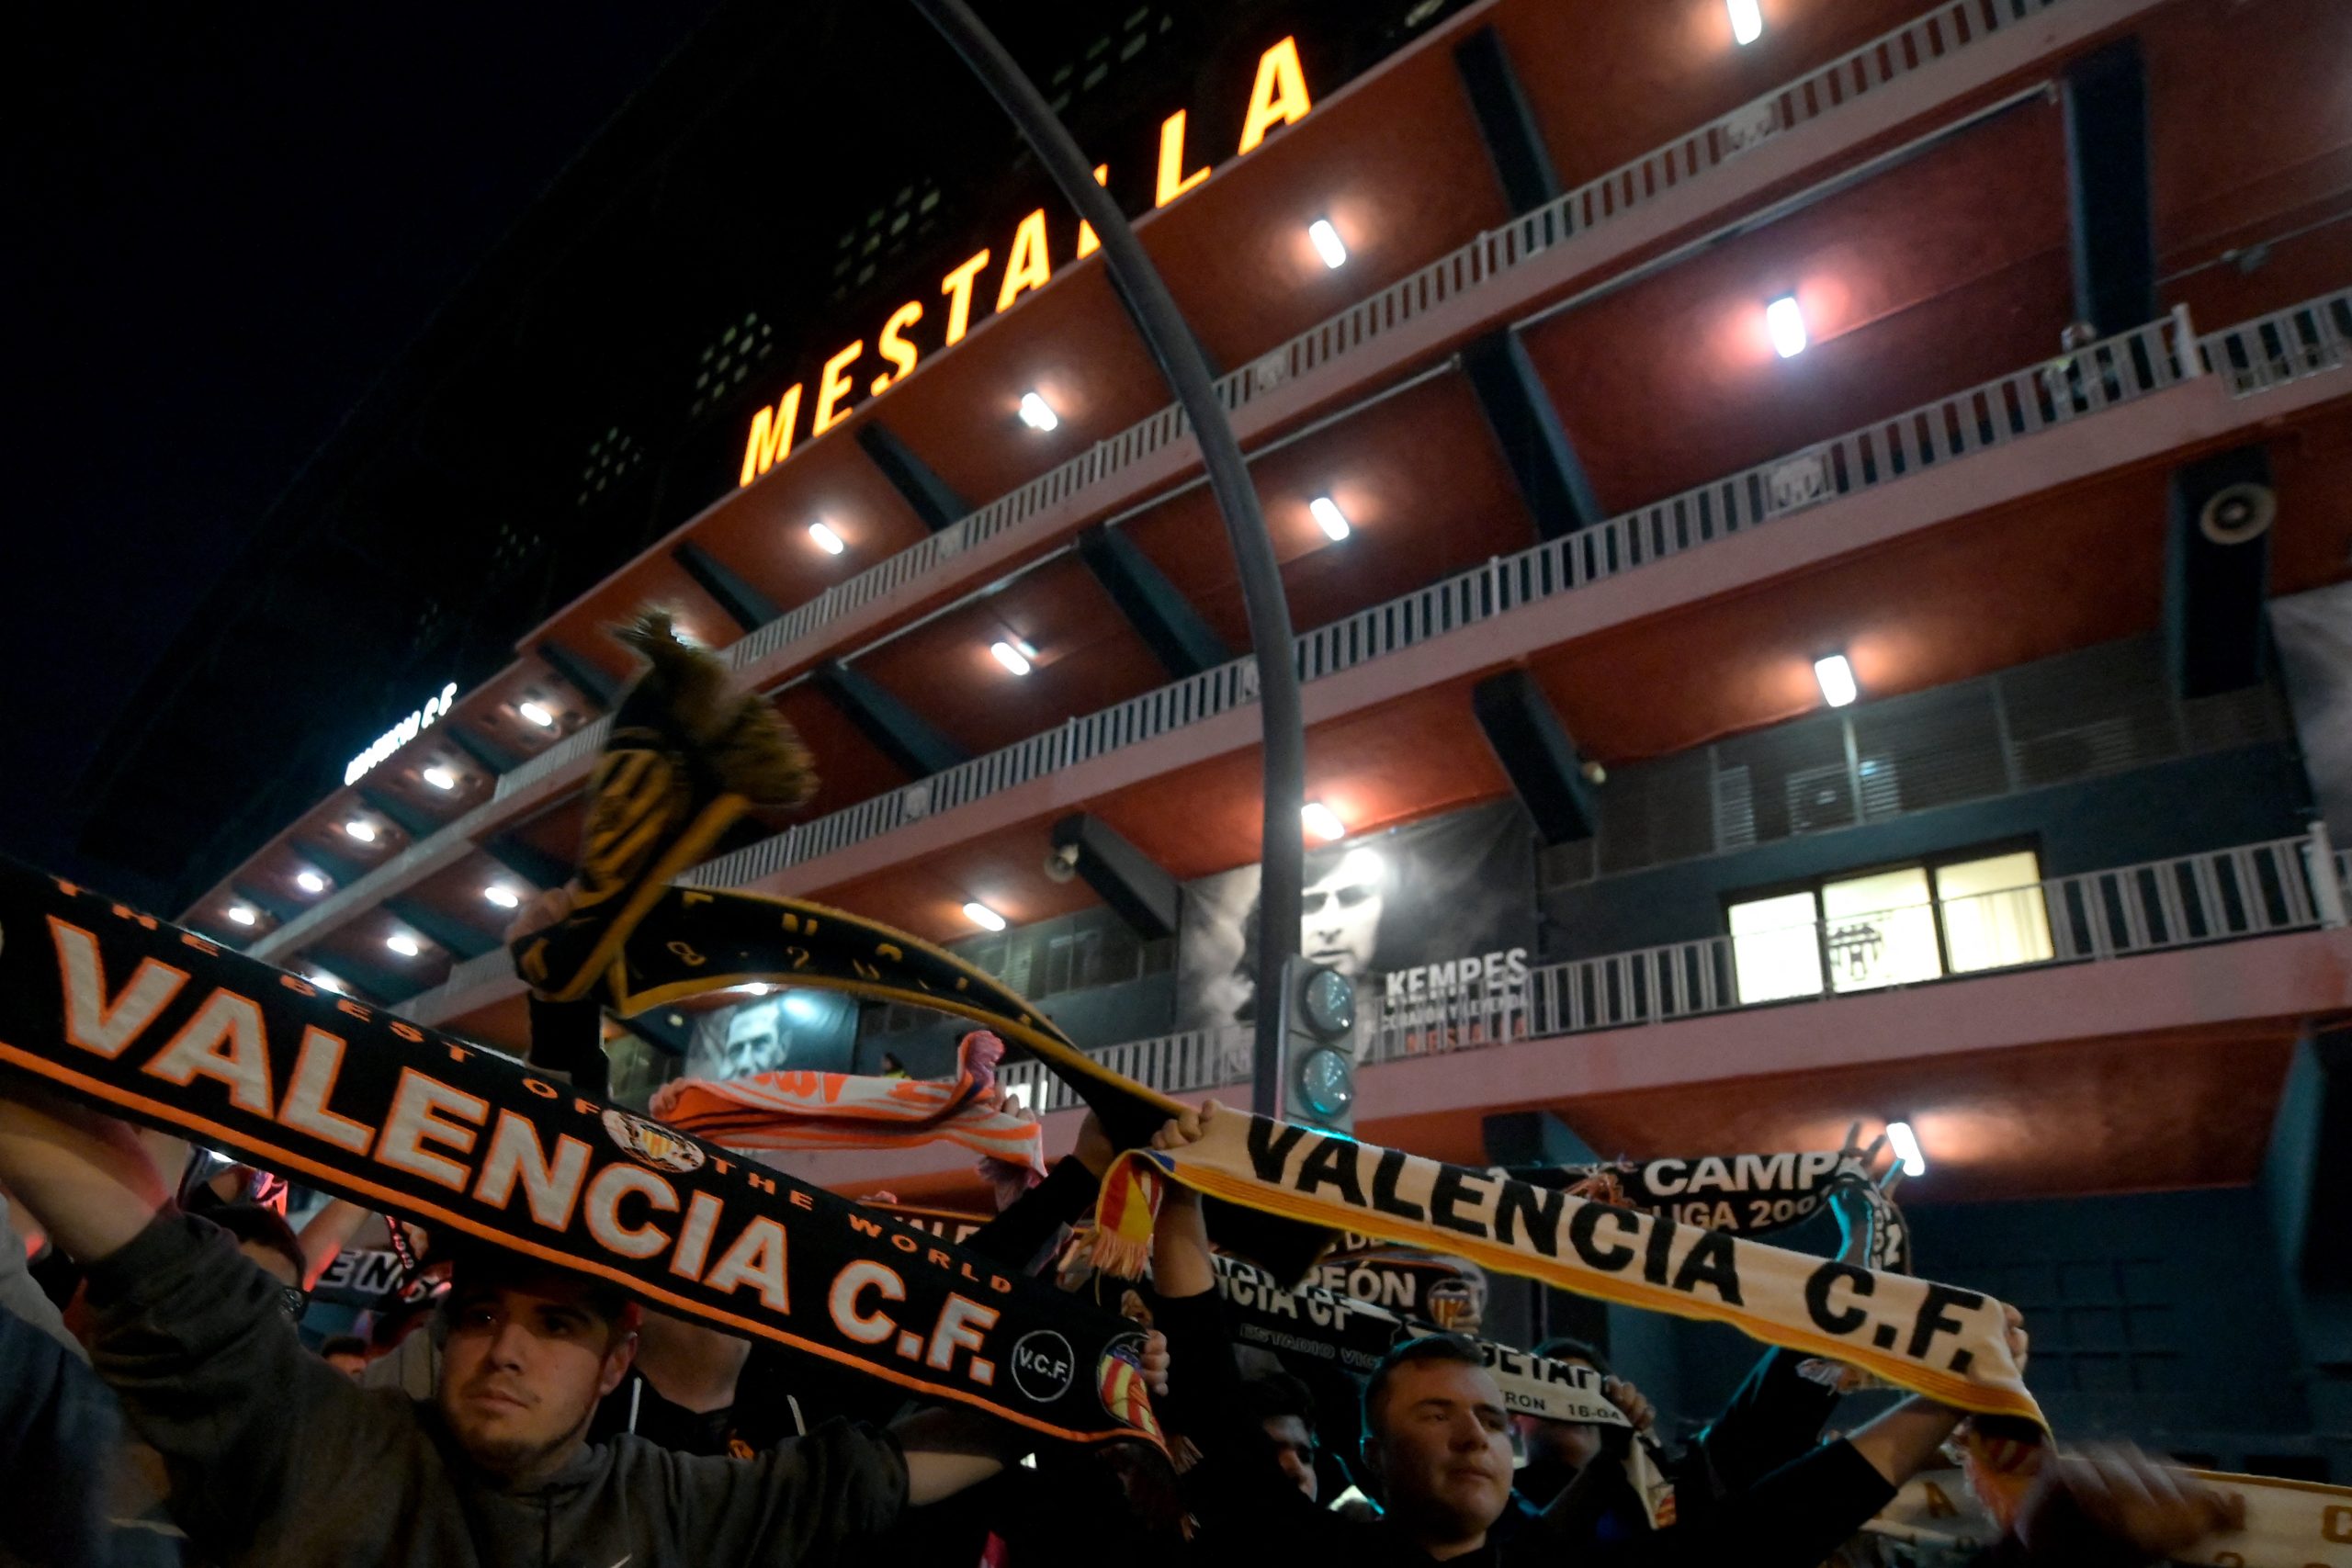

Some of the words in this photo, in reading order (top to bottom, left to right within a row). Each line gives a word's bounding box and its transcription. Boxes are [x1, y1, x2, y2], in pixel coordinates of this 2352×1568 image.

[1385, 947, 1529, 1008] KEMPES
[46, 913, 792, 1316] VALENCIA
[828, 1258, 1002, 1386] C.F.
[55, 878, 220, 958] THE
[281, 974, 477, 1064] BEST
[521, 1077, 603, 1118] OF
[707, 1155, 815, 1213] THE
[847, 1213, 1014, 1294] WORLD
[1246, 1113, 1744, 1306] VALENCIA
[1804, 1259, 1985, 1374] C.F.
[1019, 1346, 1069, 1383] V.C.F.
[1500, 1390, 1546, 1410] RON
